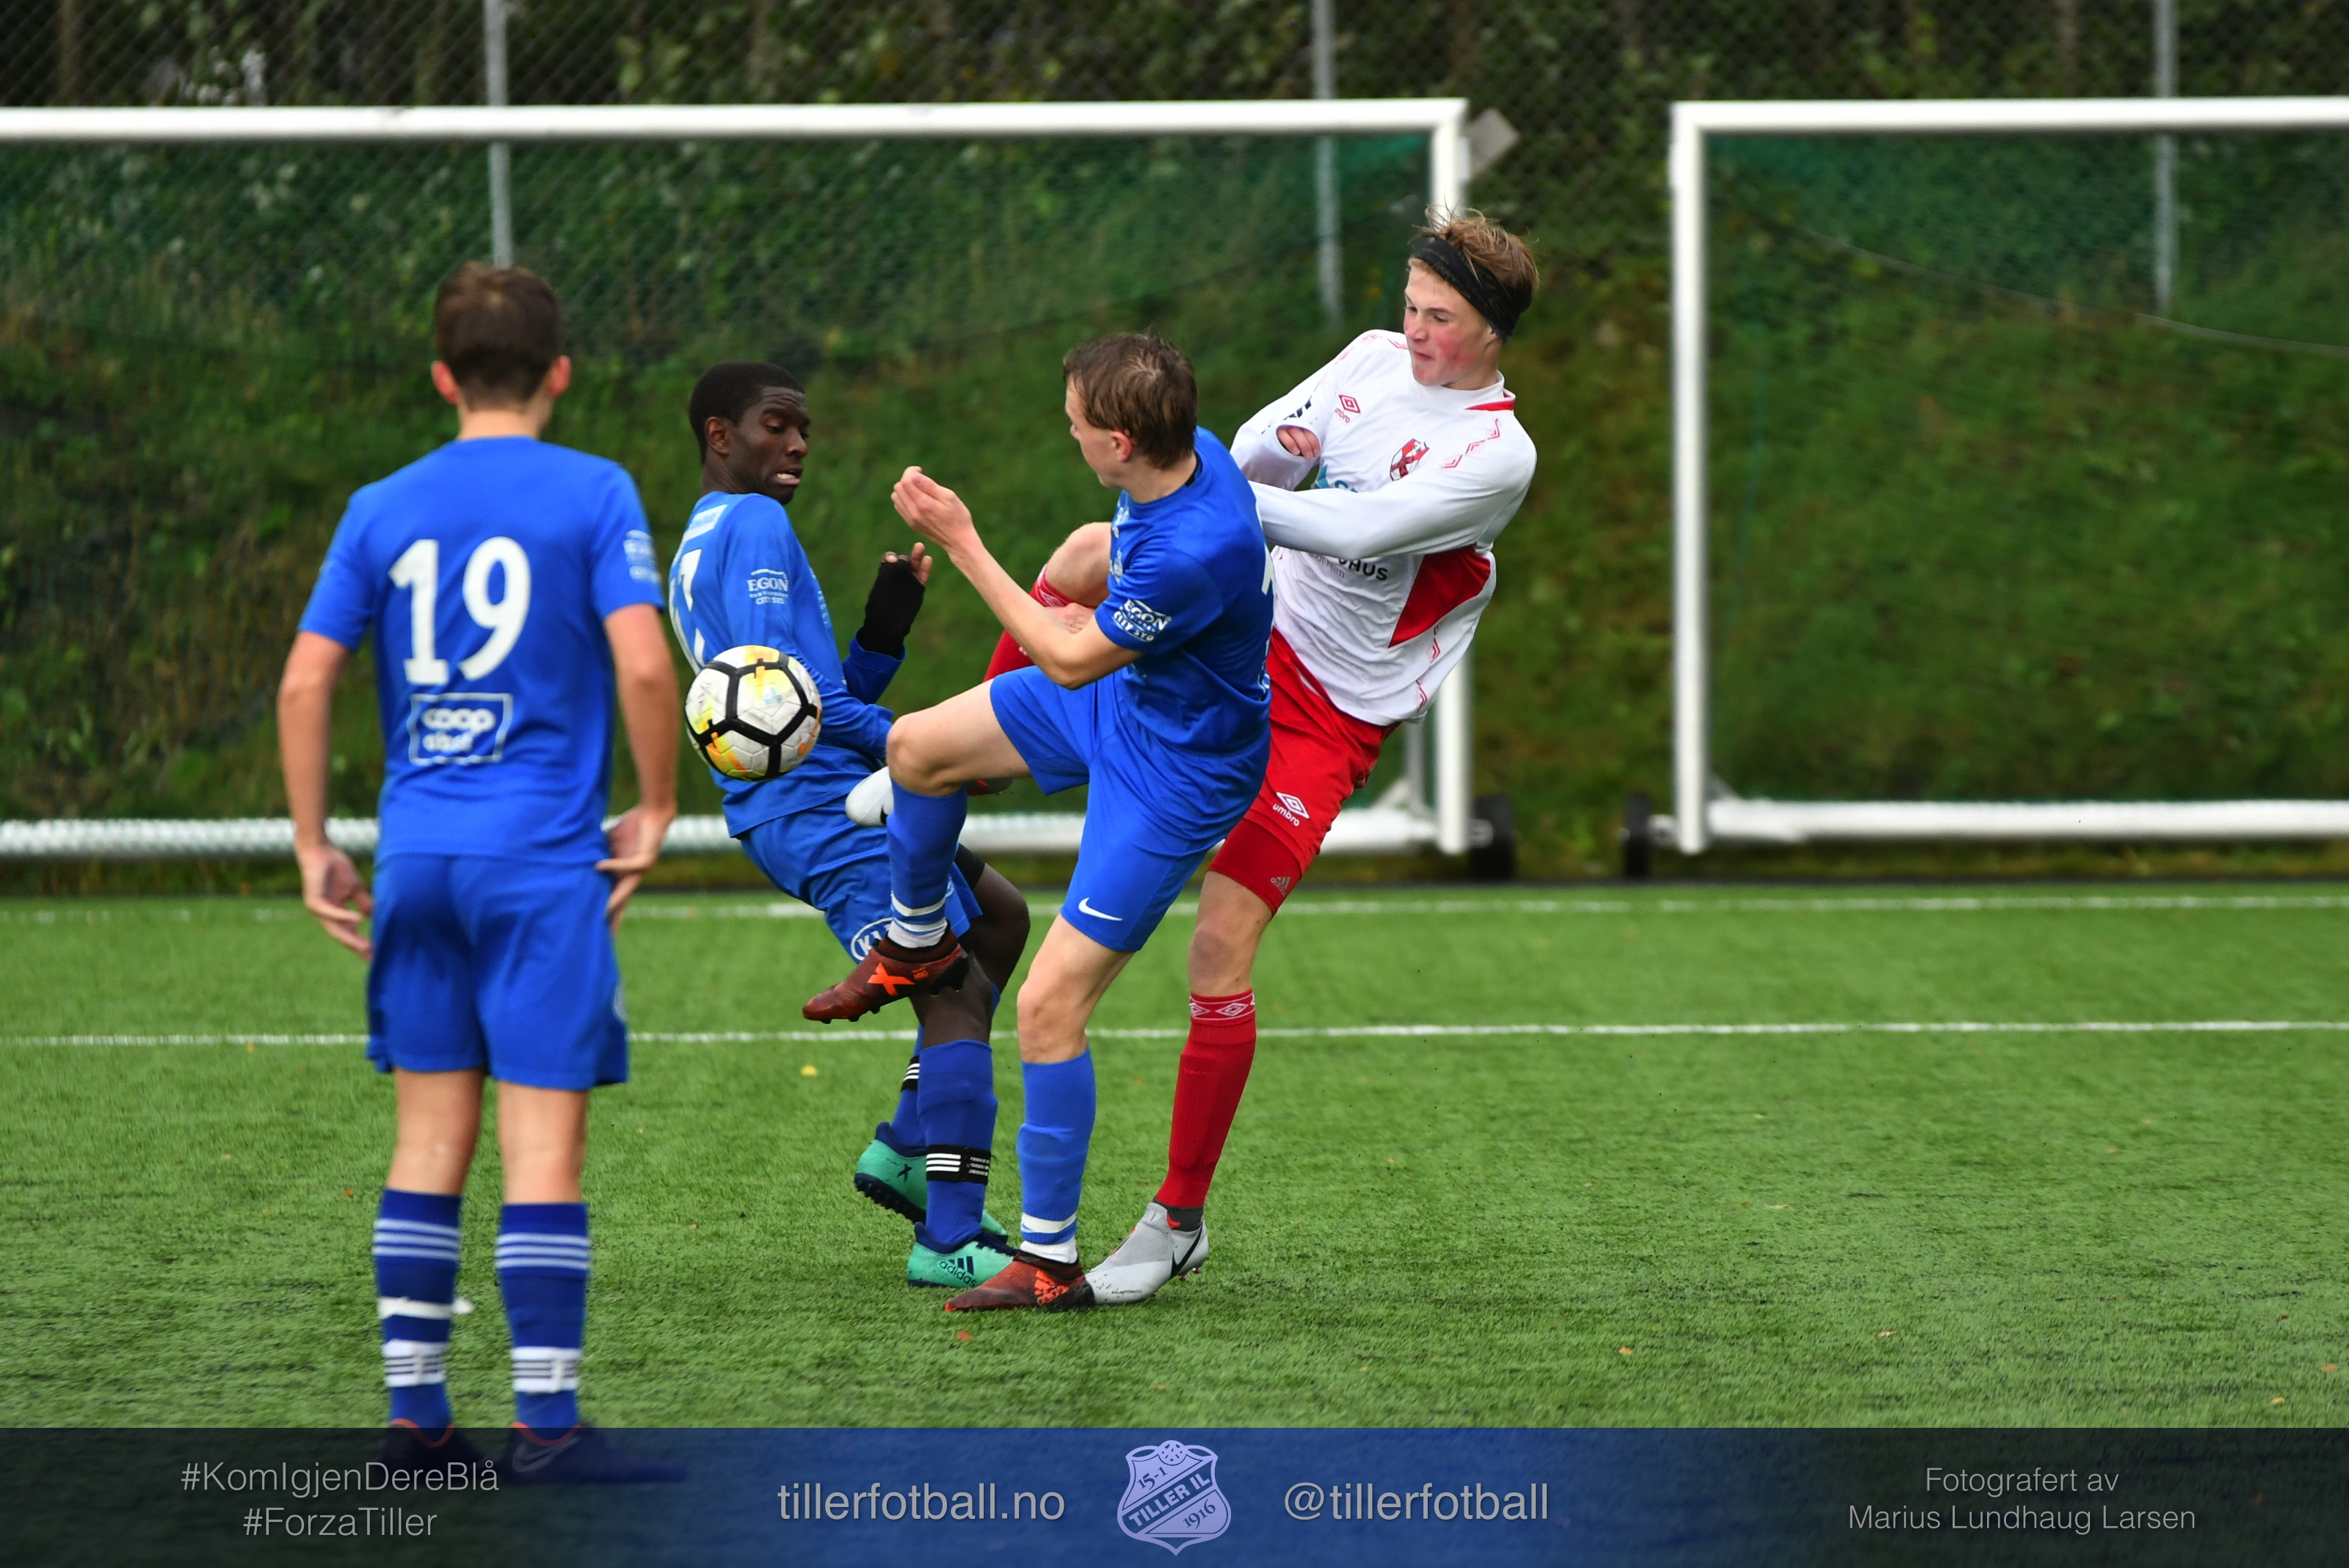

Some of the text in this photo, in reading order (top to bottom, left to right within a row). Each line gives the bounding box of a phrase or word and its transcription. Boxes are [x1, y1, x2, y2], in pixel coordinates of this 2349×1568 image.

[747, 577, 788, 592] EGON
[388, 536, 531, 686] 19
[1124, 599, 1169, 631] EGON
[1272, 803, 1300, 827] umbro
[940, 1261, 977, 1288] adidas
